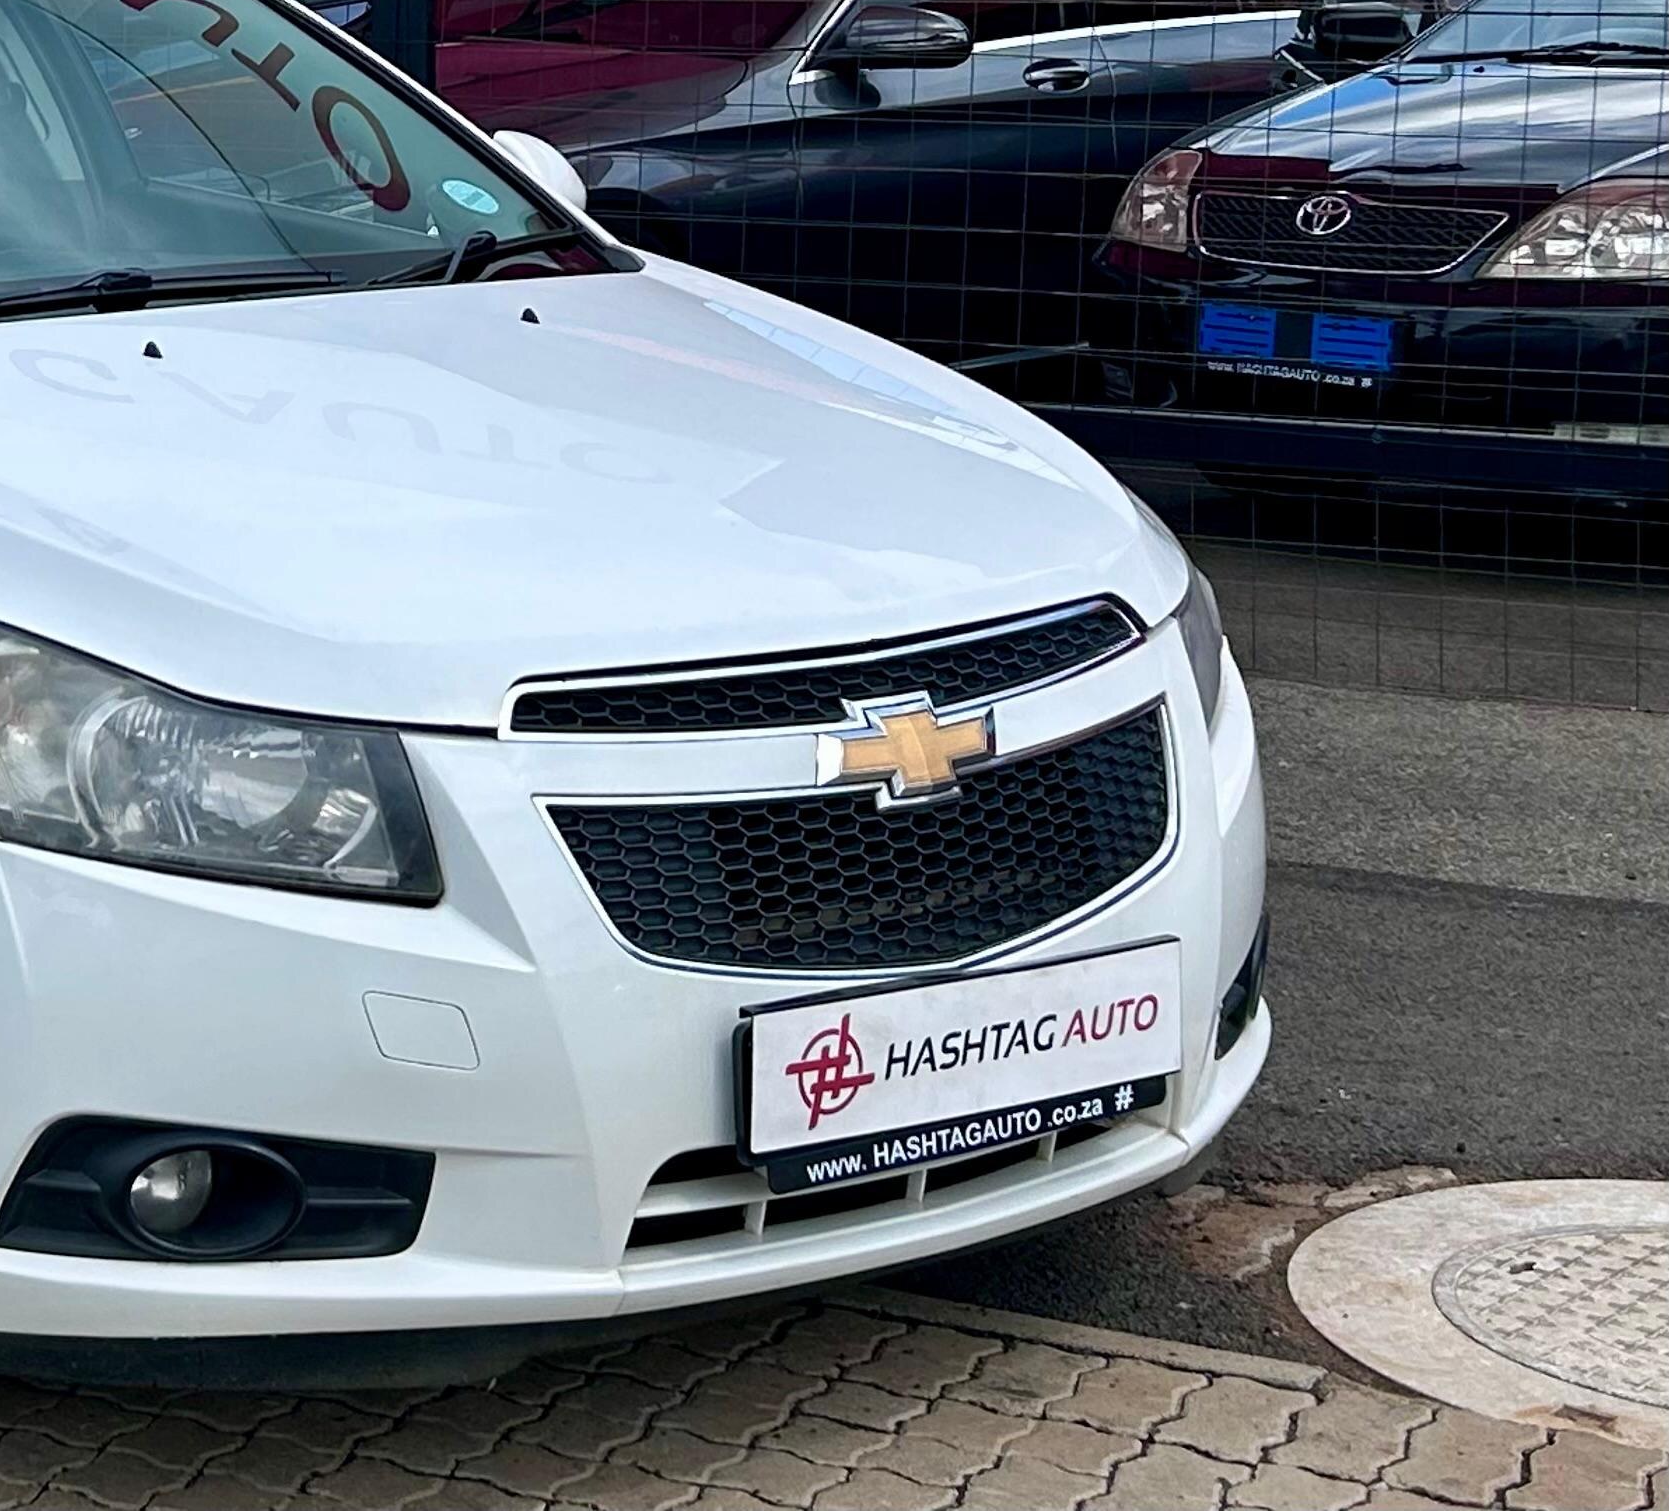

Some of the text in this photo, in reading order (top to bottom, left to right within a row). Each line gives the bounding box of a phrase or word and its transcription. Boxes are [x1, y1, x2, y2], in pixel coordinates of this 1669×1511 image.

[885, 994, 1159, 1080] HASHTAG AUTO
[806, 1154, 867, 1183] www.
[873, 1110, 1042, 1168] HASHTAGAUTO
